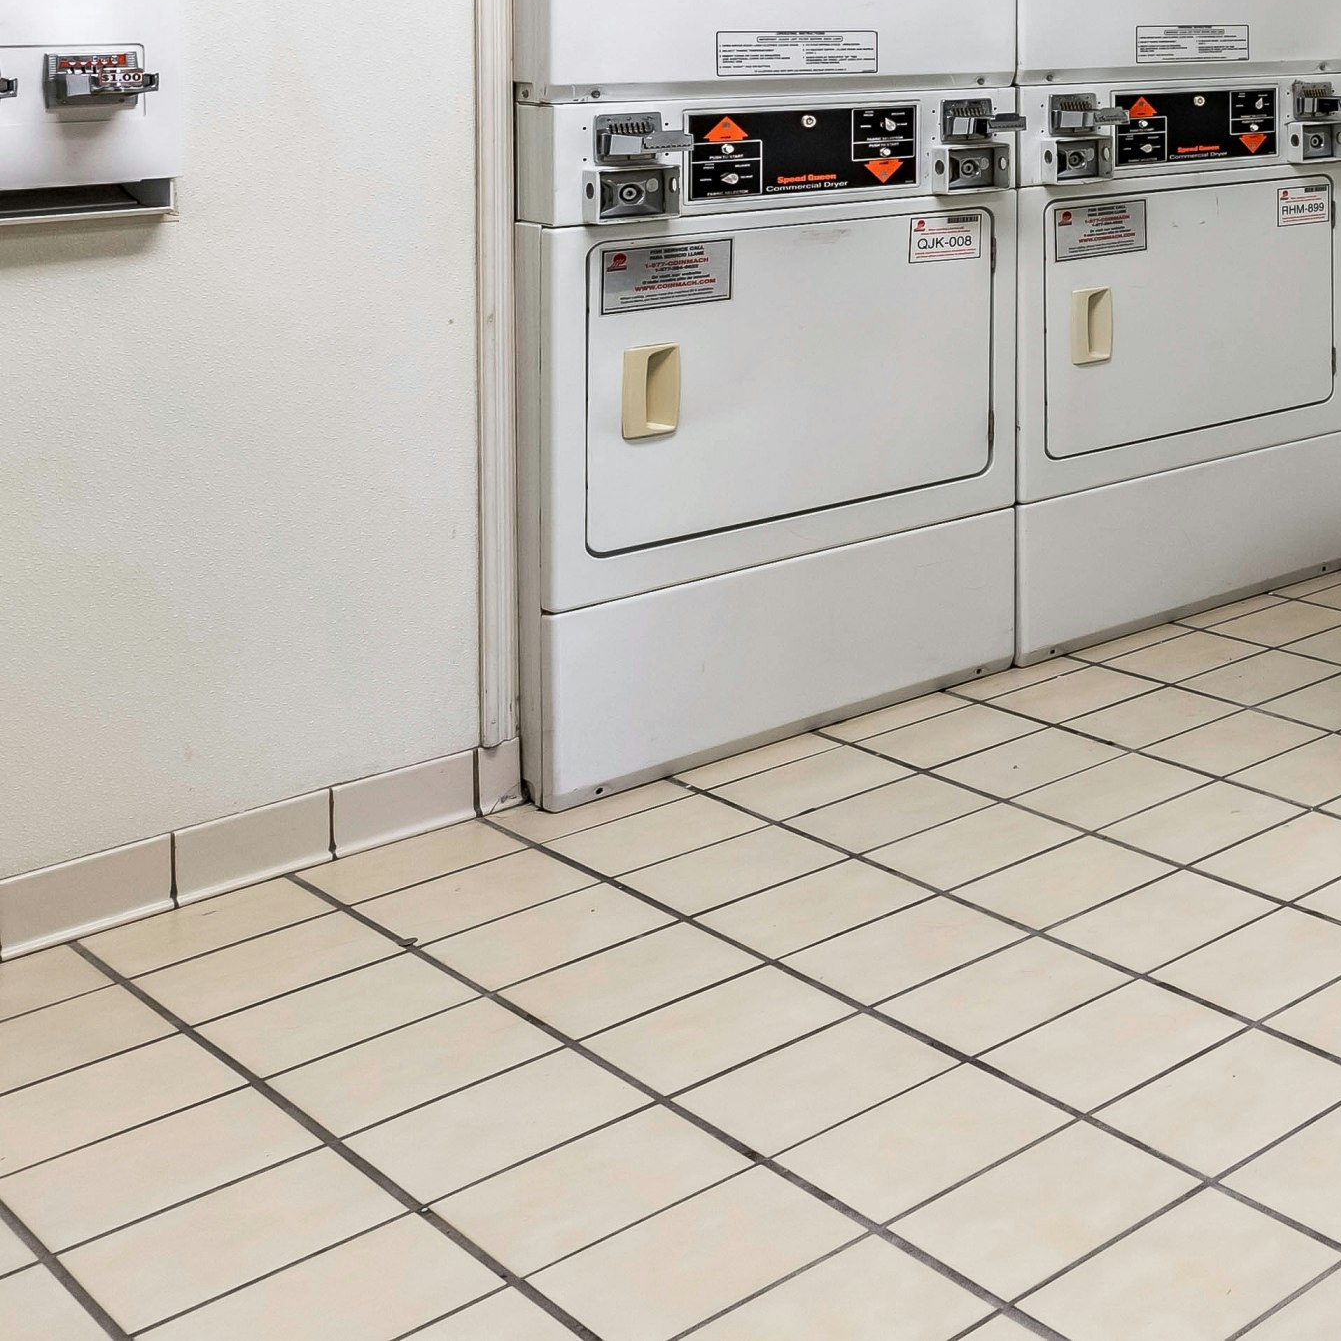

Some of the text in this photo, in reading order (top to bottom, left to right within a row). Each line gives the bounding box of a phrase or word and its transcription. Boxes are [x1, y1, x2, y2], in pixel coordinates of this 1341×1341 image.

[101, 72, 142, 83] $1.00
[778, 175, 806, 184] Speed
[766, 183, 821, 192] Commercial
[917, 235, 972, 250] QJK-008
[635, 279, 715, 291] WWW.COINMACH.COM
